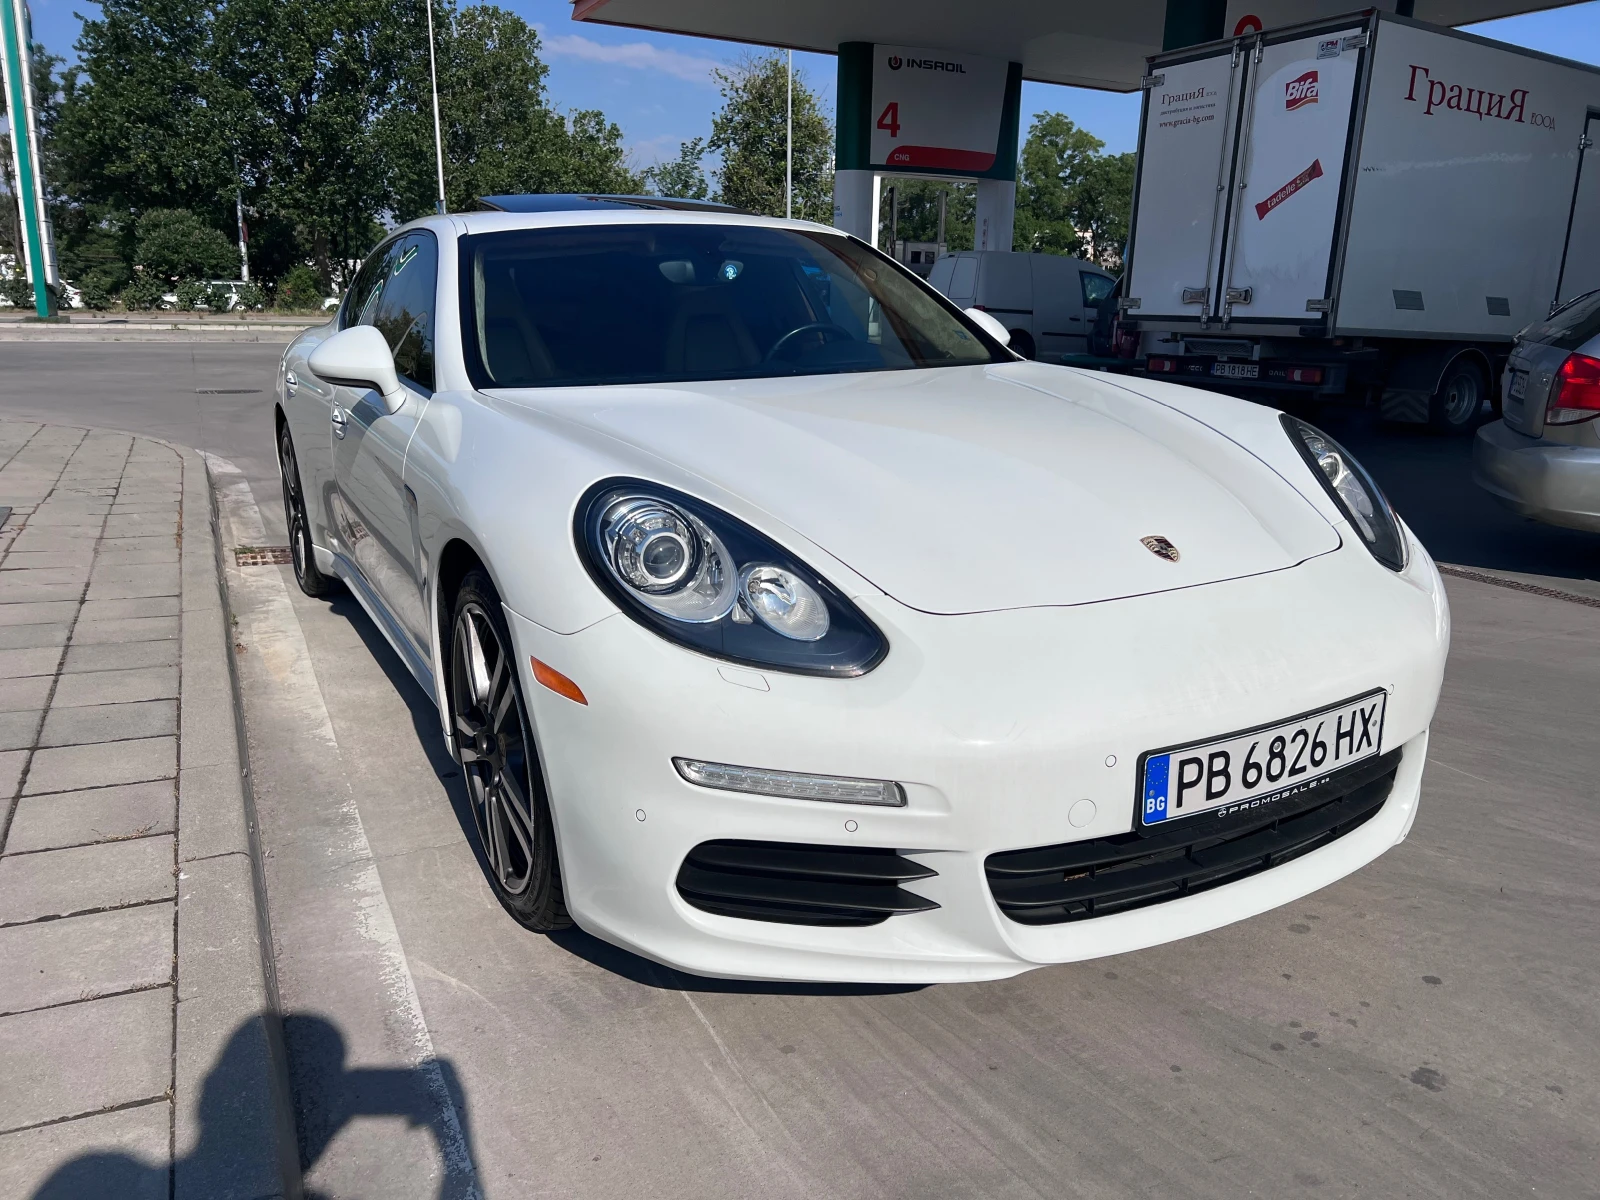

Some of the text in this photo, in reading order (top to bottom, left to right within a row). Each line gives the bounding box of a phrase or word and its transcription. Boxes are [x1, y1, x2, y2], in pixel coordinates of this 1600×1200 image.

[1161, 87, 1206, 106] ГрациЯ
[1286, 78, 1318, 99] Bifa
[1404, 64, 1530, 123] ГрациЯ
[877, 102, 901, 137] 4
[894, 153, 910, 161] CNG
[1267, 183, 1296, 208] tadelle
[1176, 703, 1378, 809] PB 6826 HX
[1146, 796, 1165, 813] BG
